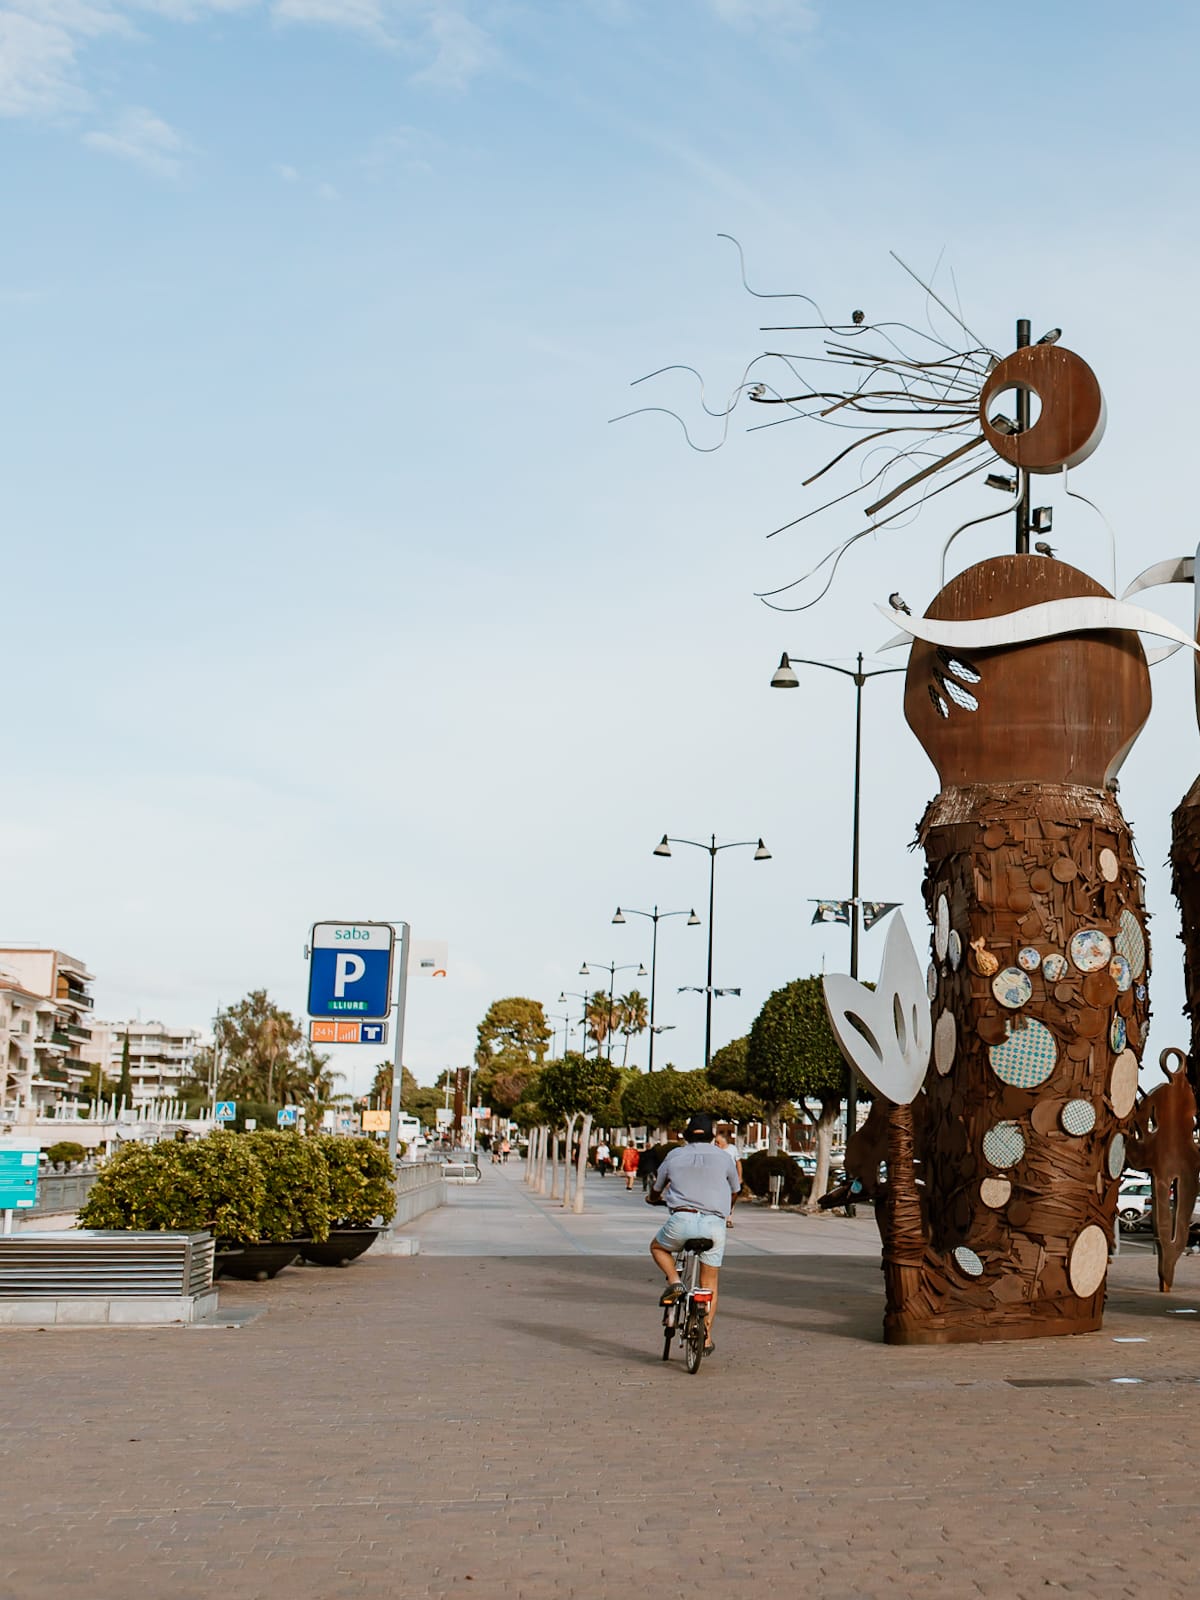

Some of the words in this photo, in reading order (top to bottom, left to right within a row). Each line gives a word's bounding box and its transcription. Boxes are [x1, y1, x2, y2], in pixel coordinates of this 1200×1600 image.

[335, 927, 370, 940] saba
[334, 953, 366, 998] P
[333, 1001, 364, 1010] LLIURE
